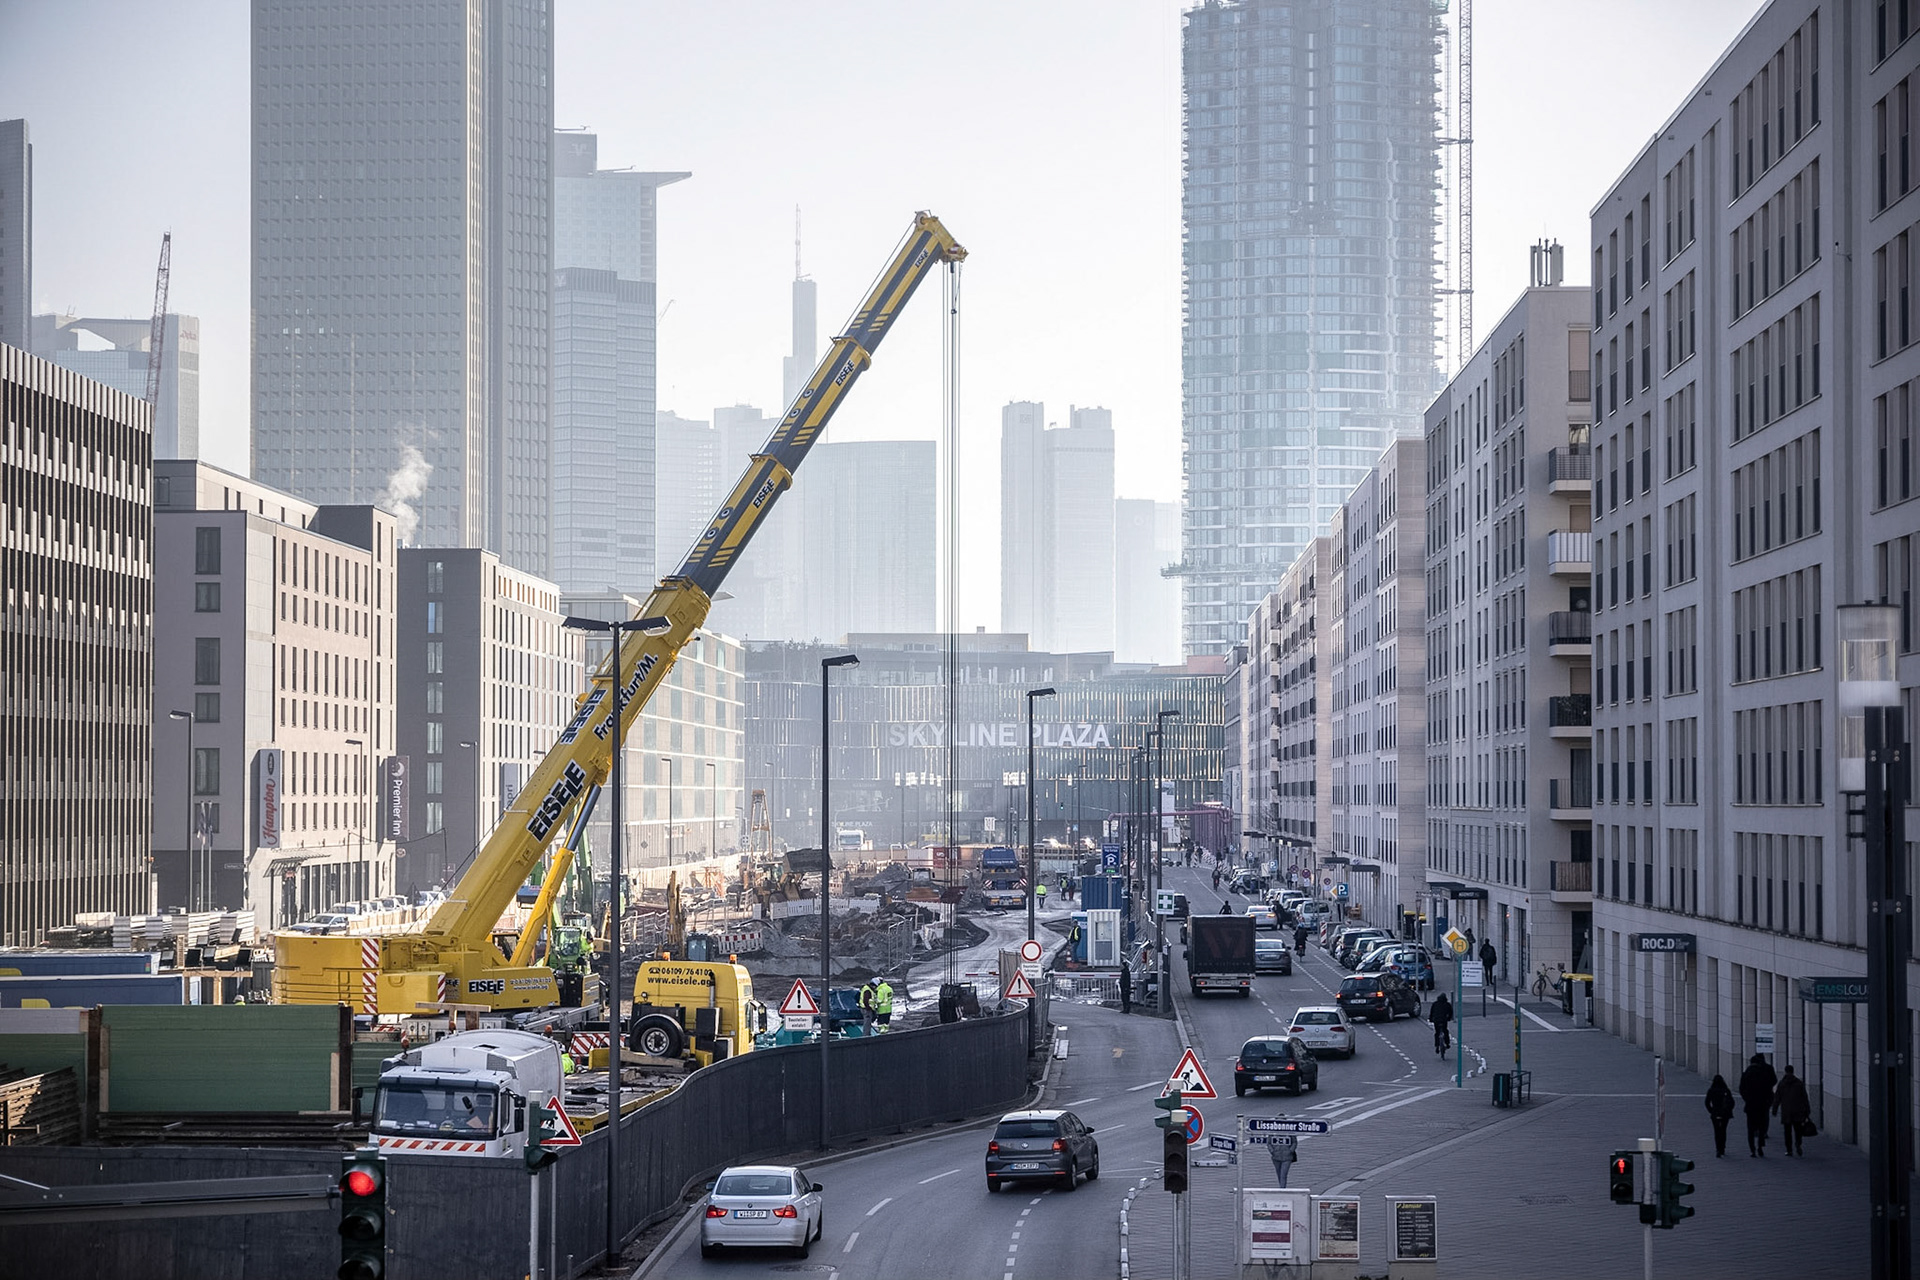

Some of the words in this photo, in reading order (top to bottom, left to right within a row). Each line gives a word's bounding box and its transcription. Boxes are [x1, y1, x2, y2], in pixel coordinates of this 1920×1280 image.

[836, 360, 855, 387] EISELE
[753, 478, 775, 509] EISELE
[595, 654, 658, 740] Frakfurt/M.
[560, 688, 607, 744] EISELE
[889, 723, 1017, 746] SKYLINE
[1026, 723, 1110, 746] PLAZA
[393, 779, 403, 818] Premier
[527, 759, 586, 842] EISELE
[262, 778, 278, 846] Hampton
[393, 820, 402, 835] Inn
[1642, 938, 1675, 949] ROC.D
[468, 980, 504, 995] EISELE
[648, 976, 712, 987] www.eisele.ag
[1816, 984, 1867, 996] EMSLOU
[1256, 1121, 1297, 1131] Lissabonner
[1298, 1122, 1320, 1132] Straße
